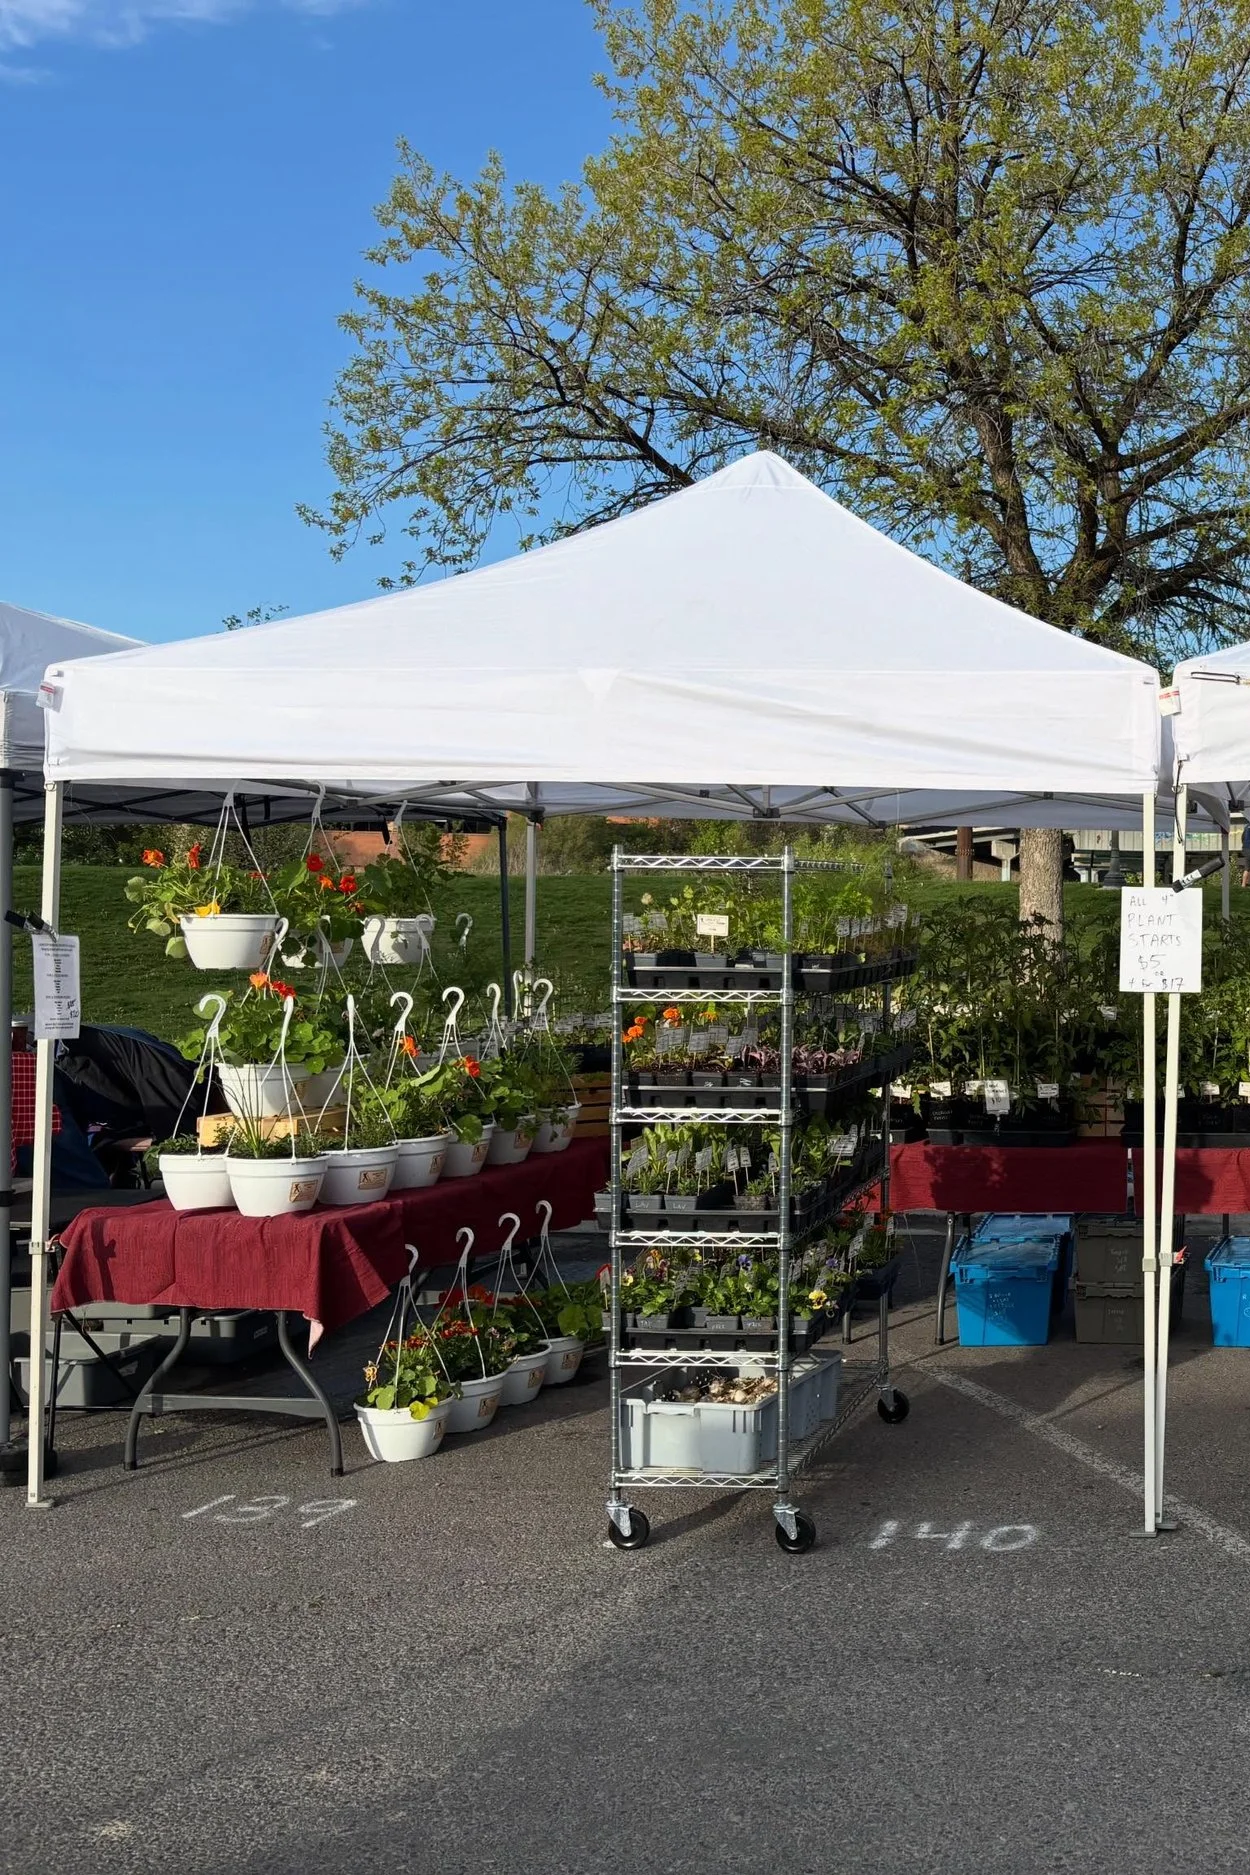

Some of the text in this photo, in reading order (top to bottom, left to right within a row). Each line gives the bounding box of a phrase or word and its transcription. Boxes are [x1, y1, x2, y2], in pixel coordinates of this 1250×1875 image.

[1129, 895, 1147, 907] ALL
[1127, 912, 1177, 928] PLANT
[1128, 933, 1182, 949] STARTS
[1138, 953, 1167, 970] $5
[180, 1494, 359, 1528] 139
[867, 1519, 1039, 1552] 140
